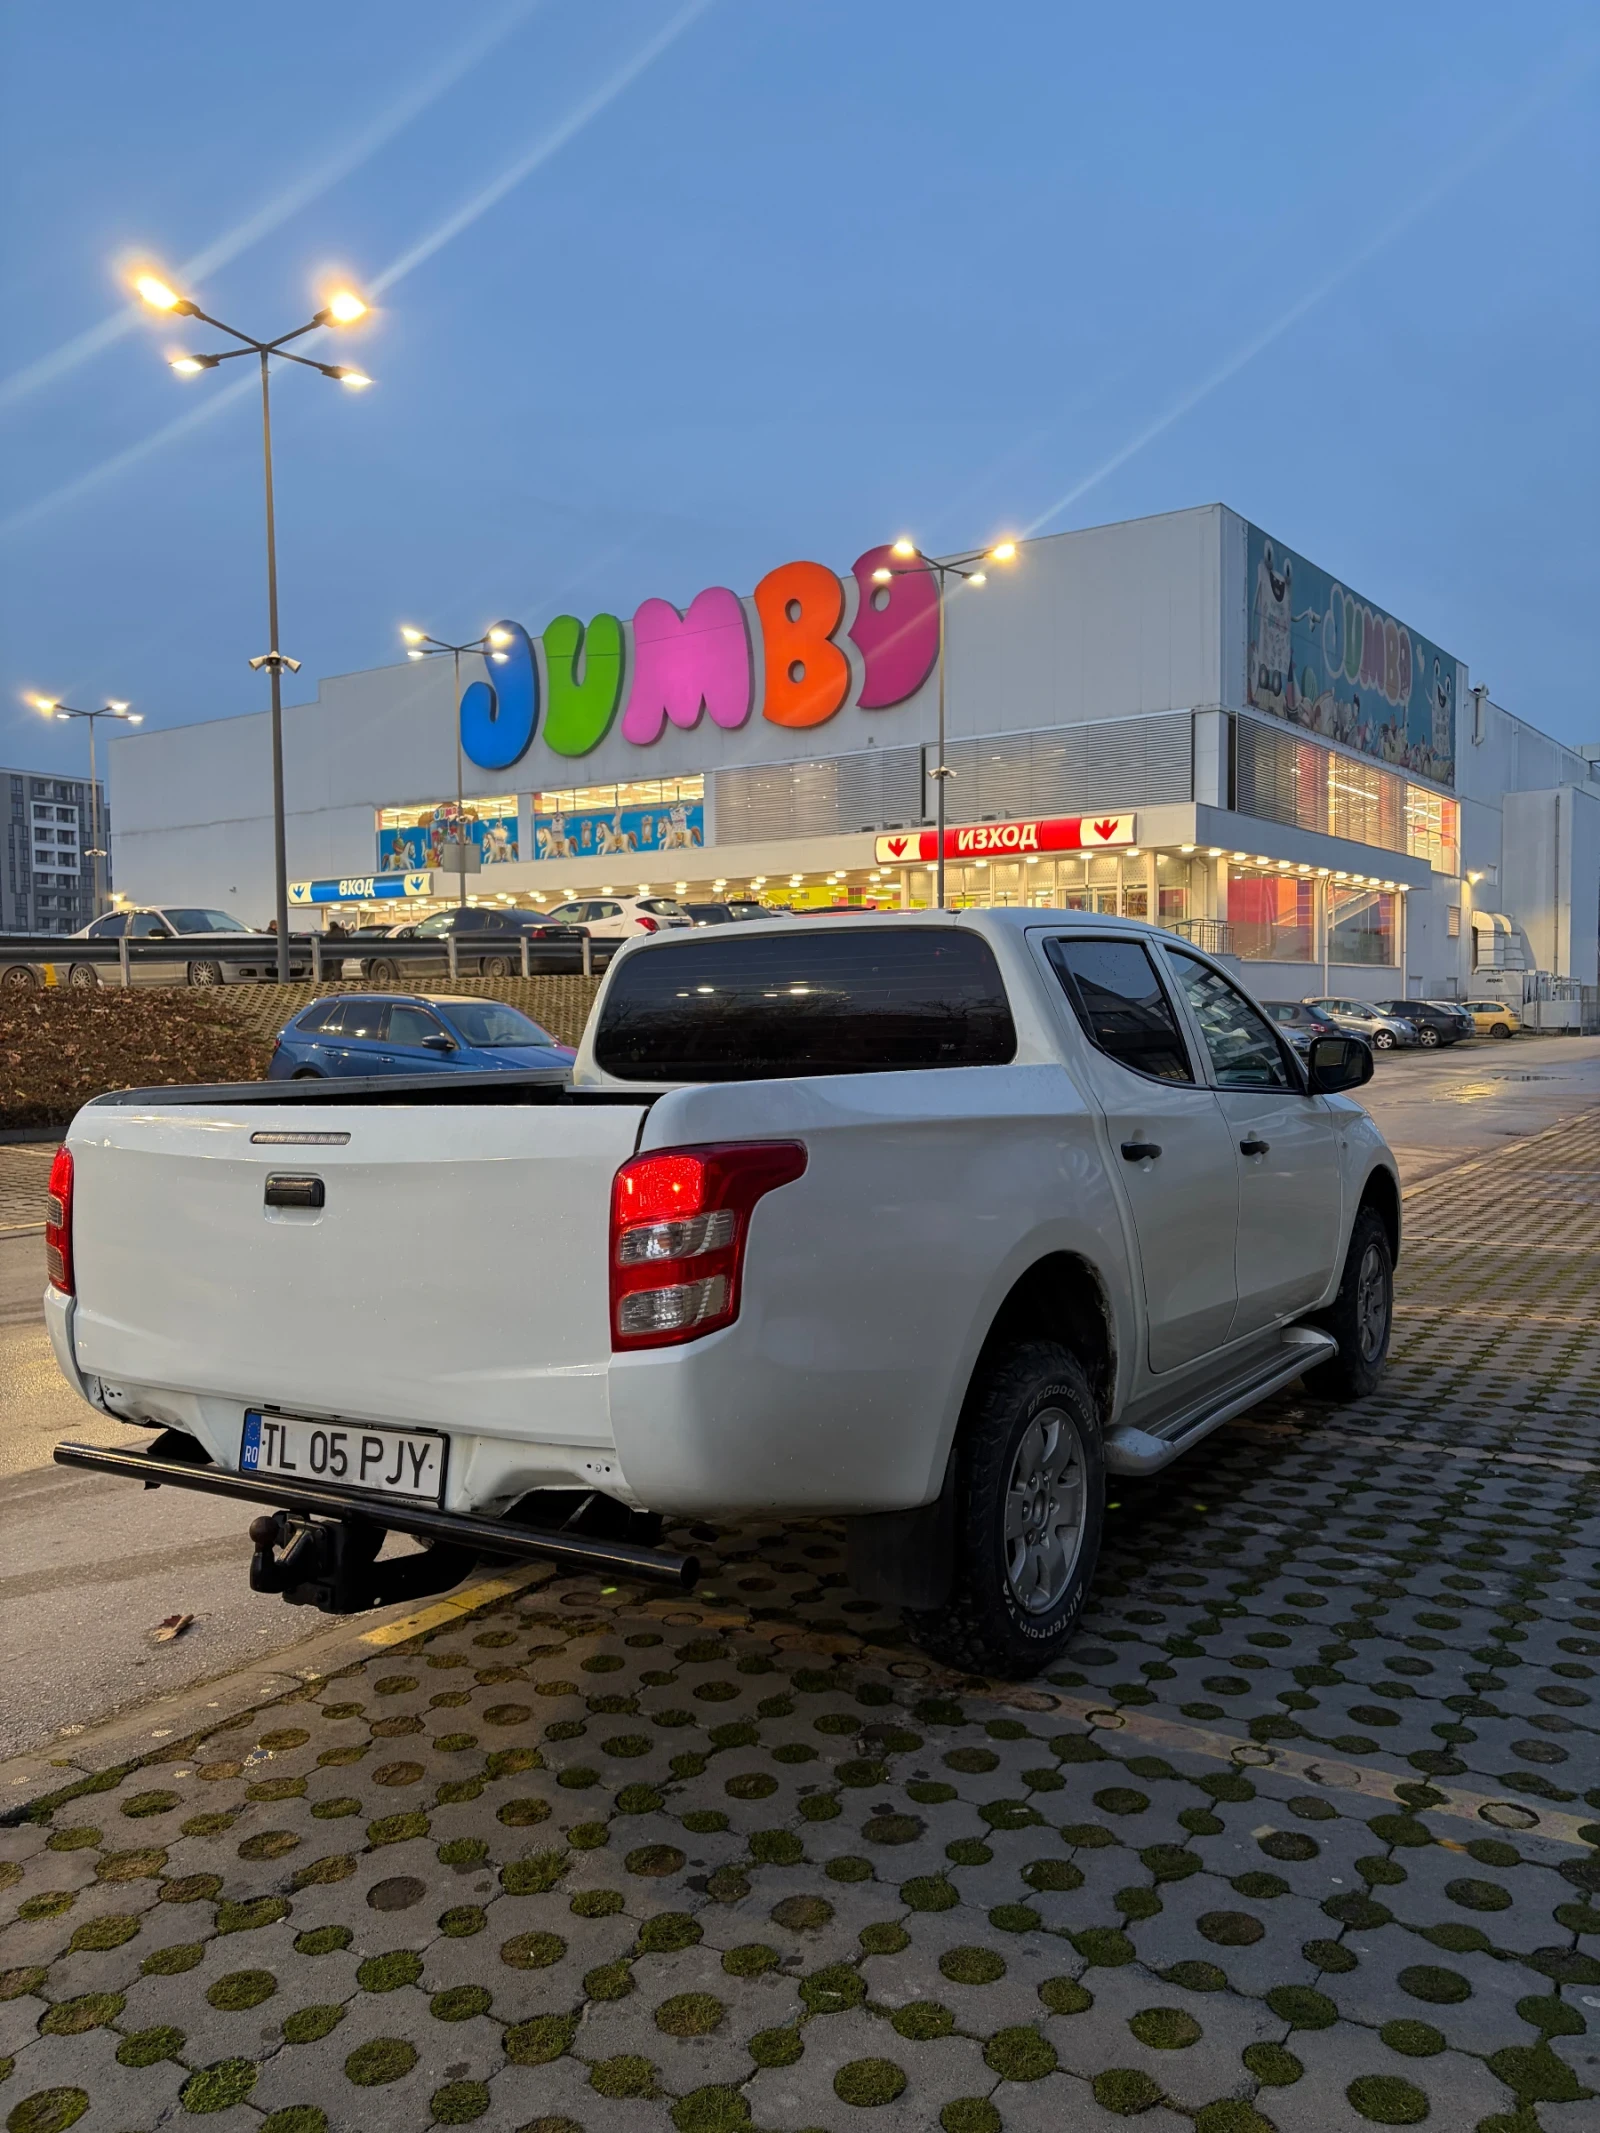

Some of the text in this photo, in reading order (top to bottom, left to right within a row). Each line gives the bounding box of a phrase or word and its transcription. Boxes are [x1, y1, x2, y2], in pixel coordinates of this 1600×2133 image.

[459, 544, 940, 770] JUMBO
[1323, 582, 1413, 707] JUMBO
[433, 805, 459, 821] JUMB
[958, 824, 1039, 851] ИЗХОД
[339, 878, 376, 898] ВХОД
[1027, 1385, 1093, 1432] BFGoodrich
[244, 1445, 258, 1464] RO
[263, 1422, 431, 1489] TL 05 PJY
